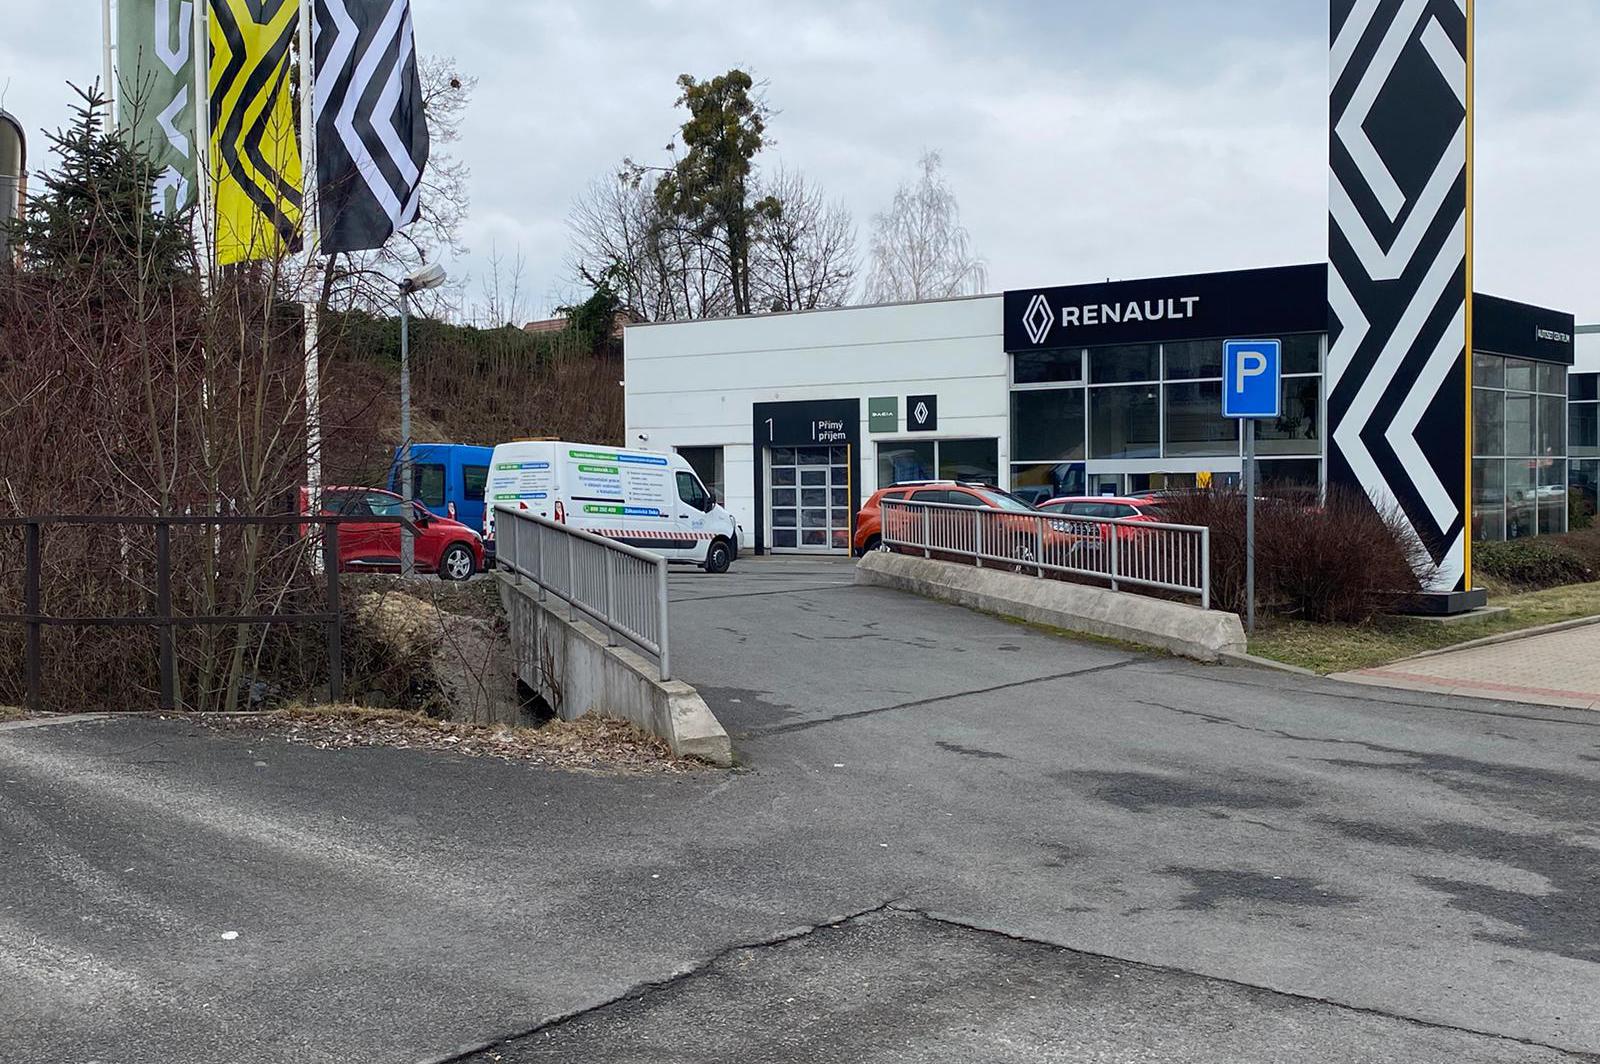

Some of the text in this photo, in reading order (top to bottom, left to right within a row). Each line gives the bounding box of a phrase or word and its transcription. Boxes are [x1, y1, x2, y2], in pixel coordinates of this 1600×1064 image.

[1061, 296, 1200, 327] RENAULT
[1236, 351, 1268, 393] P
[765, 417, 774, 441] 1
[818, 419, 844, 431] Přímý
[818, 430, 846, 442] příjem
